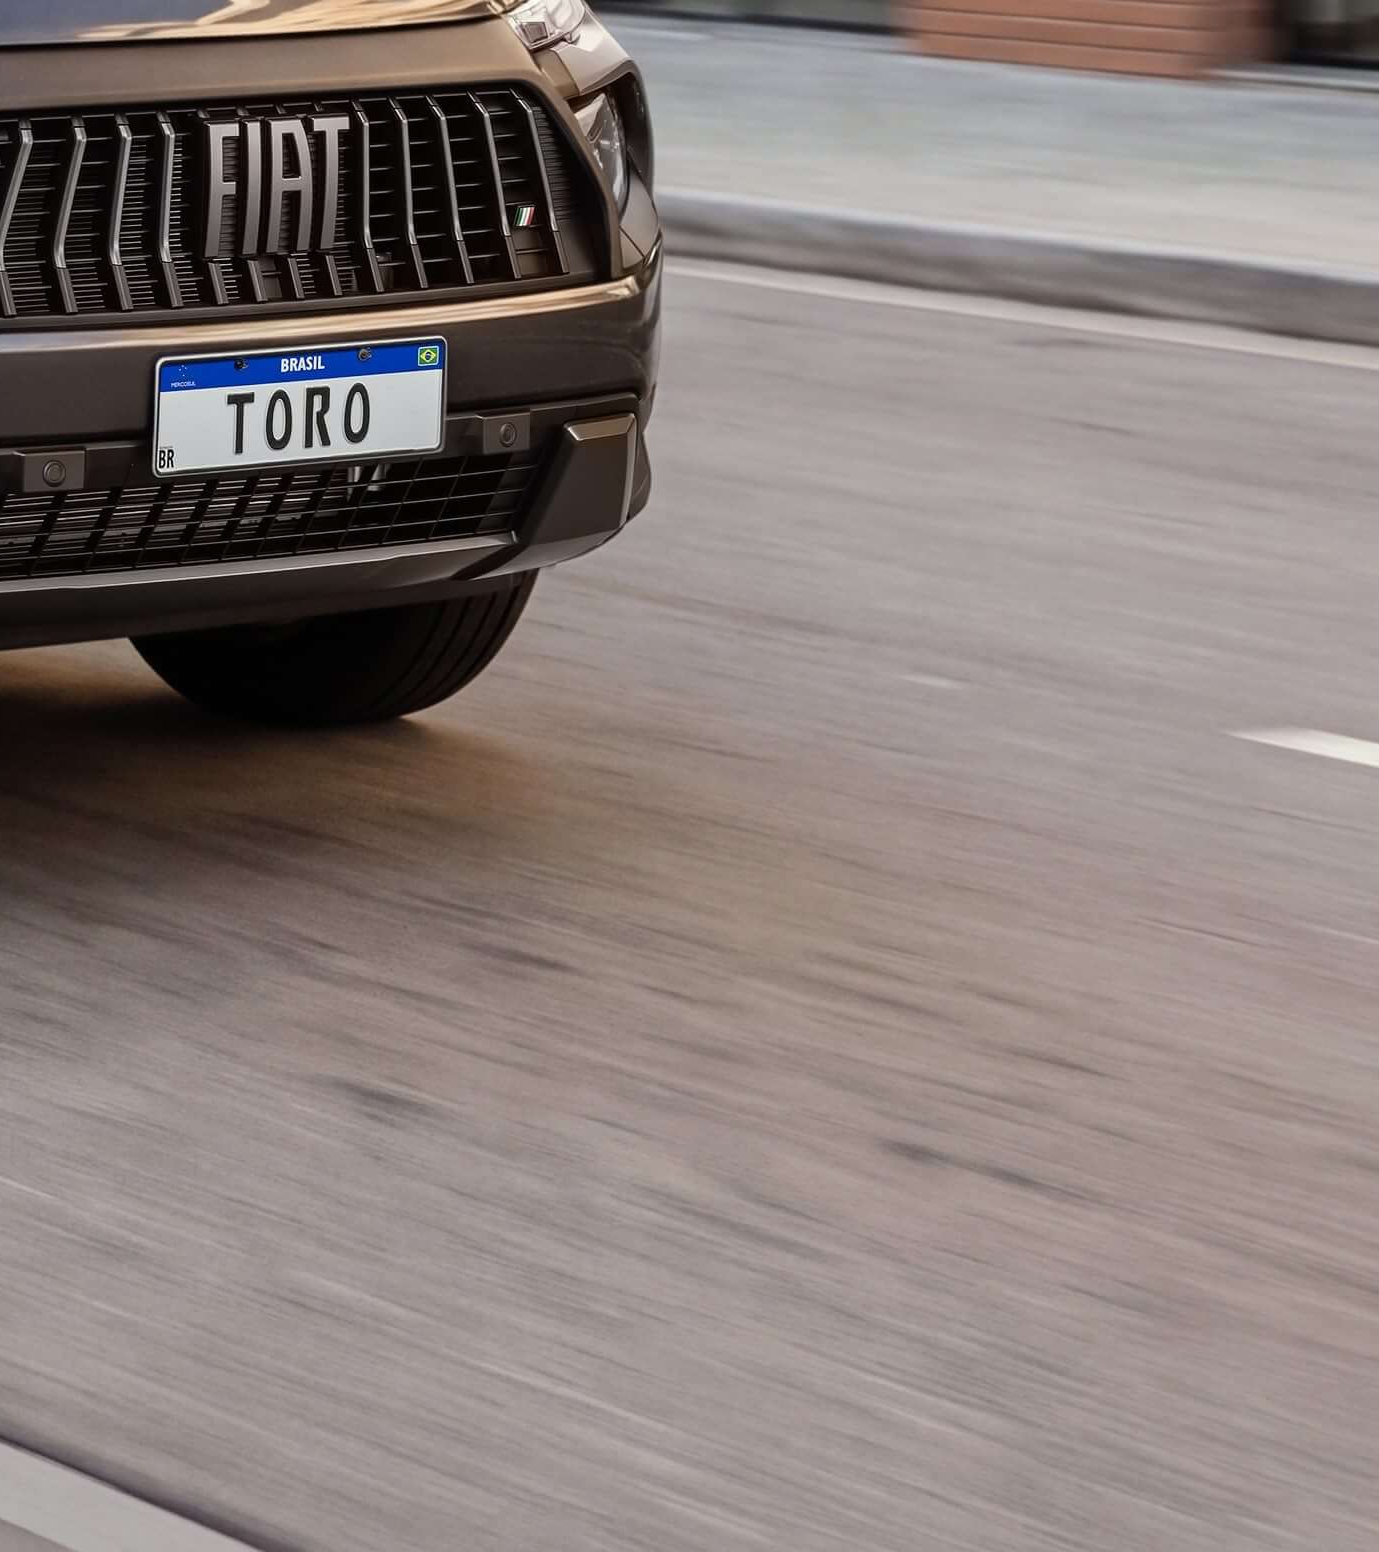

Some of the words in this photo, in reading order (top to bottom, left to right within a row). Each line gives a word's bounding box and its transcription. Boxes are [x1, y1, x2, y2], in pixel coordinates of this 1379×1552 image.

[204, 114, 350, 258] FIAT
[280, 355, 325, 373] BRASIL
[226, 382, 370, 455] TORO
[158, 449, 175, 468] BR
